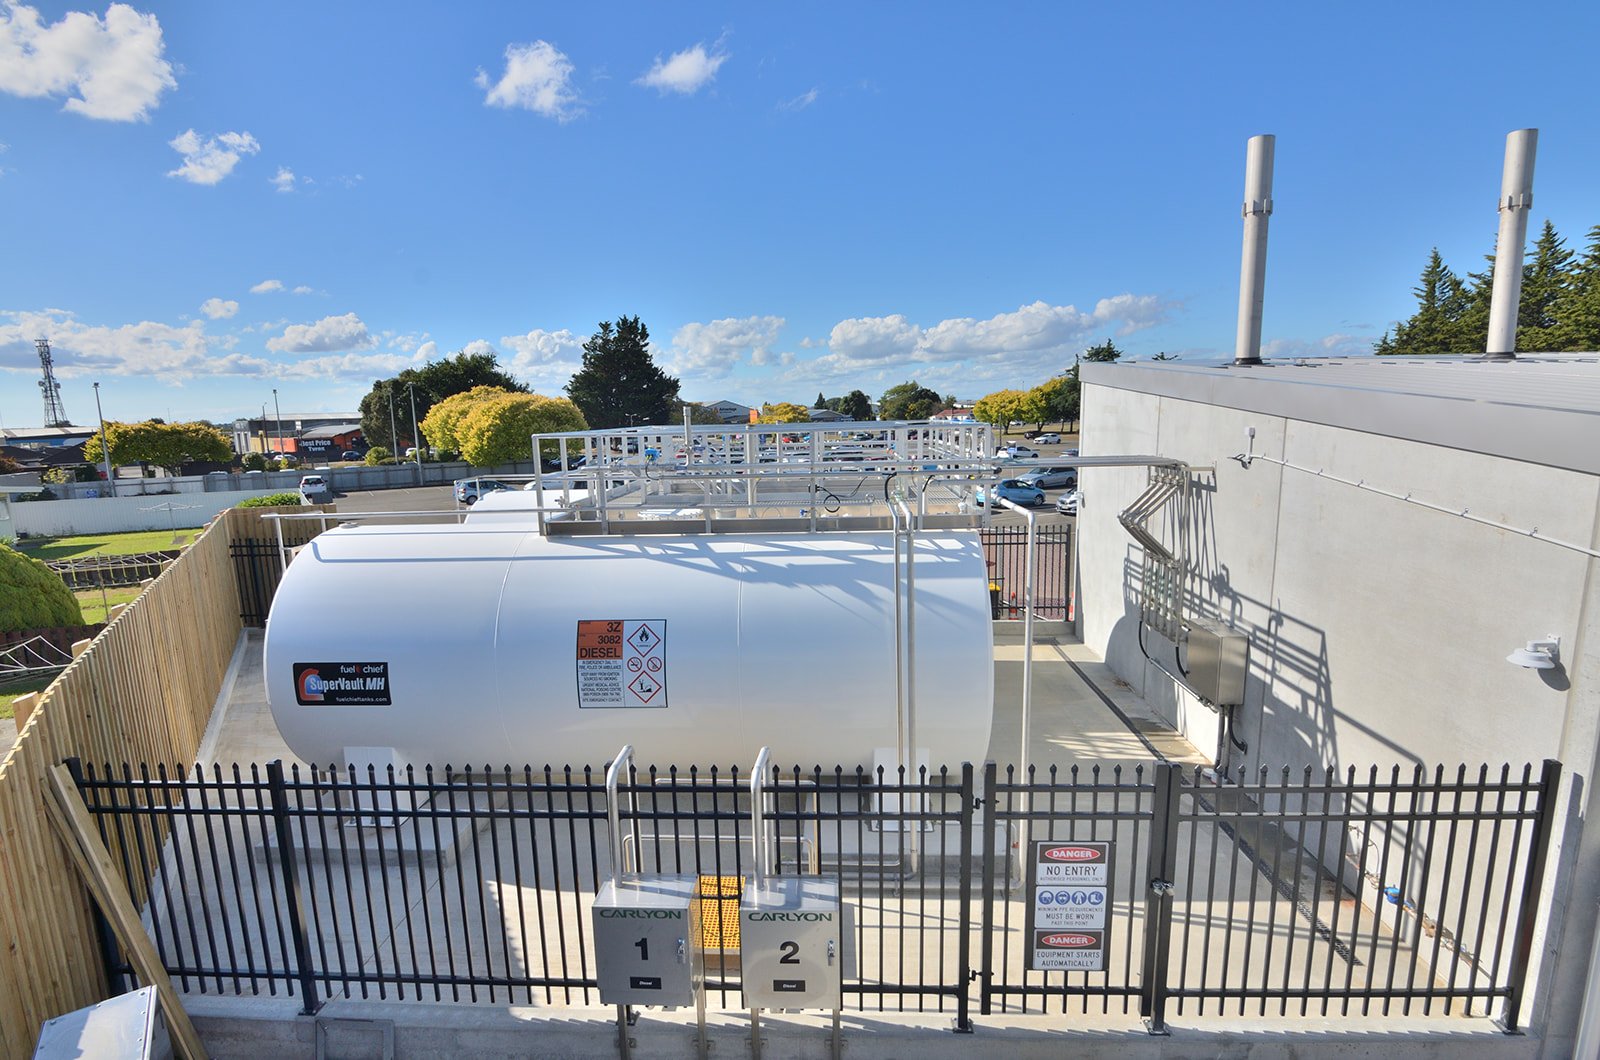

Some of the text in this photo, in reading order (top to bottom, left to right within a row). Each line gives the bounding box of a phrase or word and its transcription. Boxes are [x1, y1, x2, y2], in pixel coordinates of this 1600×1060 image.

[606, 622, 621, 632] 3Z
[598, 635, 620, 644] 3082
[580, 648, 620, 658] DIESEL
[340, 664, 384, 673] fuel chief
[310, 677, 385, 692] SuperVault MH
[1046, 866, 1098, 876] NO ENTRY
[600, 909, 681, 919] CARLYON
[748, 912, 832, 922] CARLYON
[635, 938, 648, 960] 1
[780, 941, 800, 964] 2
